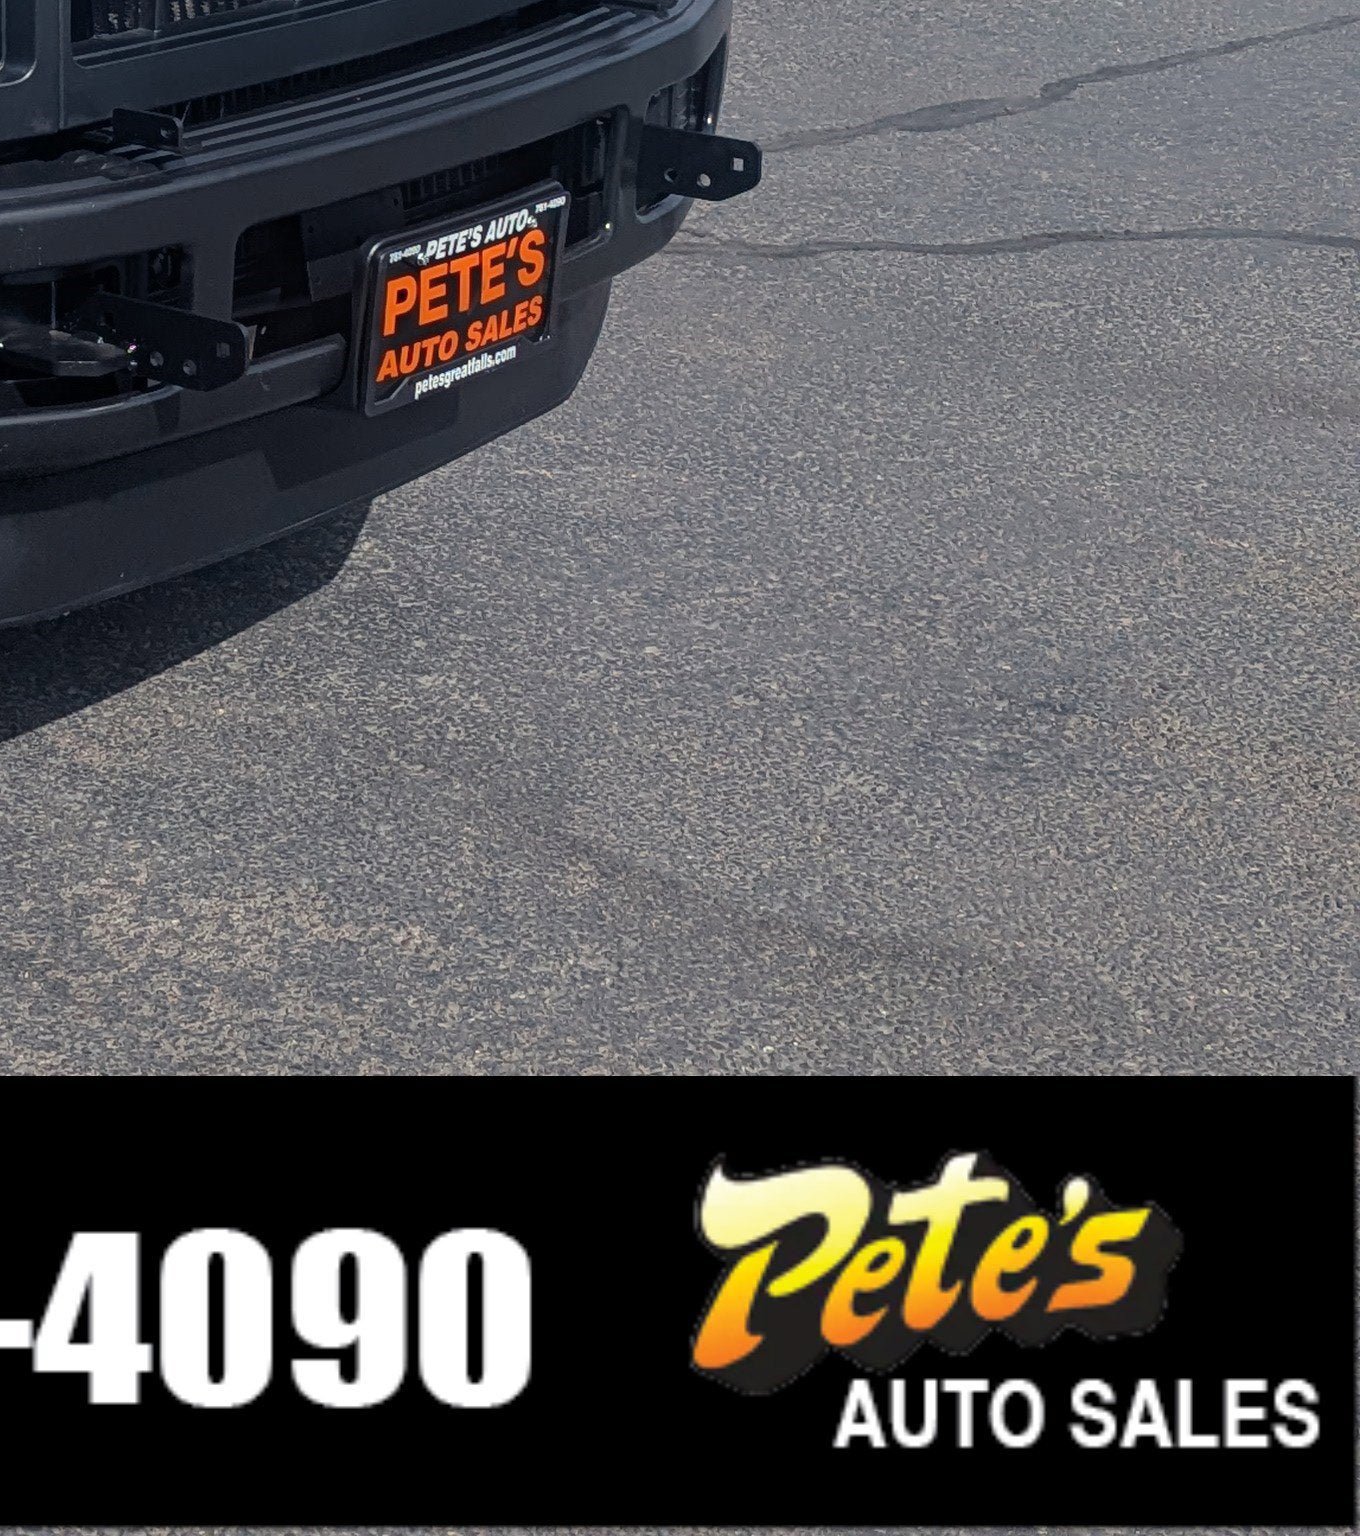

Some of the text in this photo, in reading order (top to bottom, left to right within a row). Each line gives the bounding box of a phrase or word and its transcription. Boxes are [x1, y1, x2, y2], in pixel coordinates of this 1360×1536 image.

[424, 225, 483, 261] PETE'S
[484, 209, 529, 243] AUTO
[383, 228, 546, 337] PETE'S
[376, 295, 543, 382] AUTO SALES
[414, 345, 517, 399] petesgreatfalls.com
